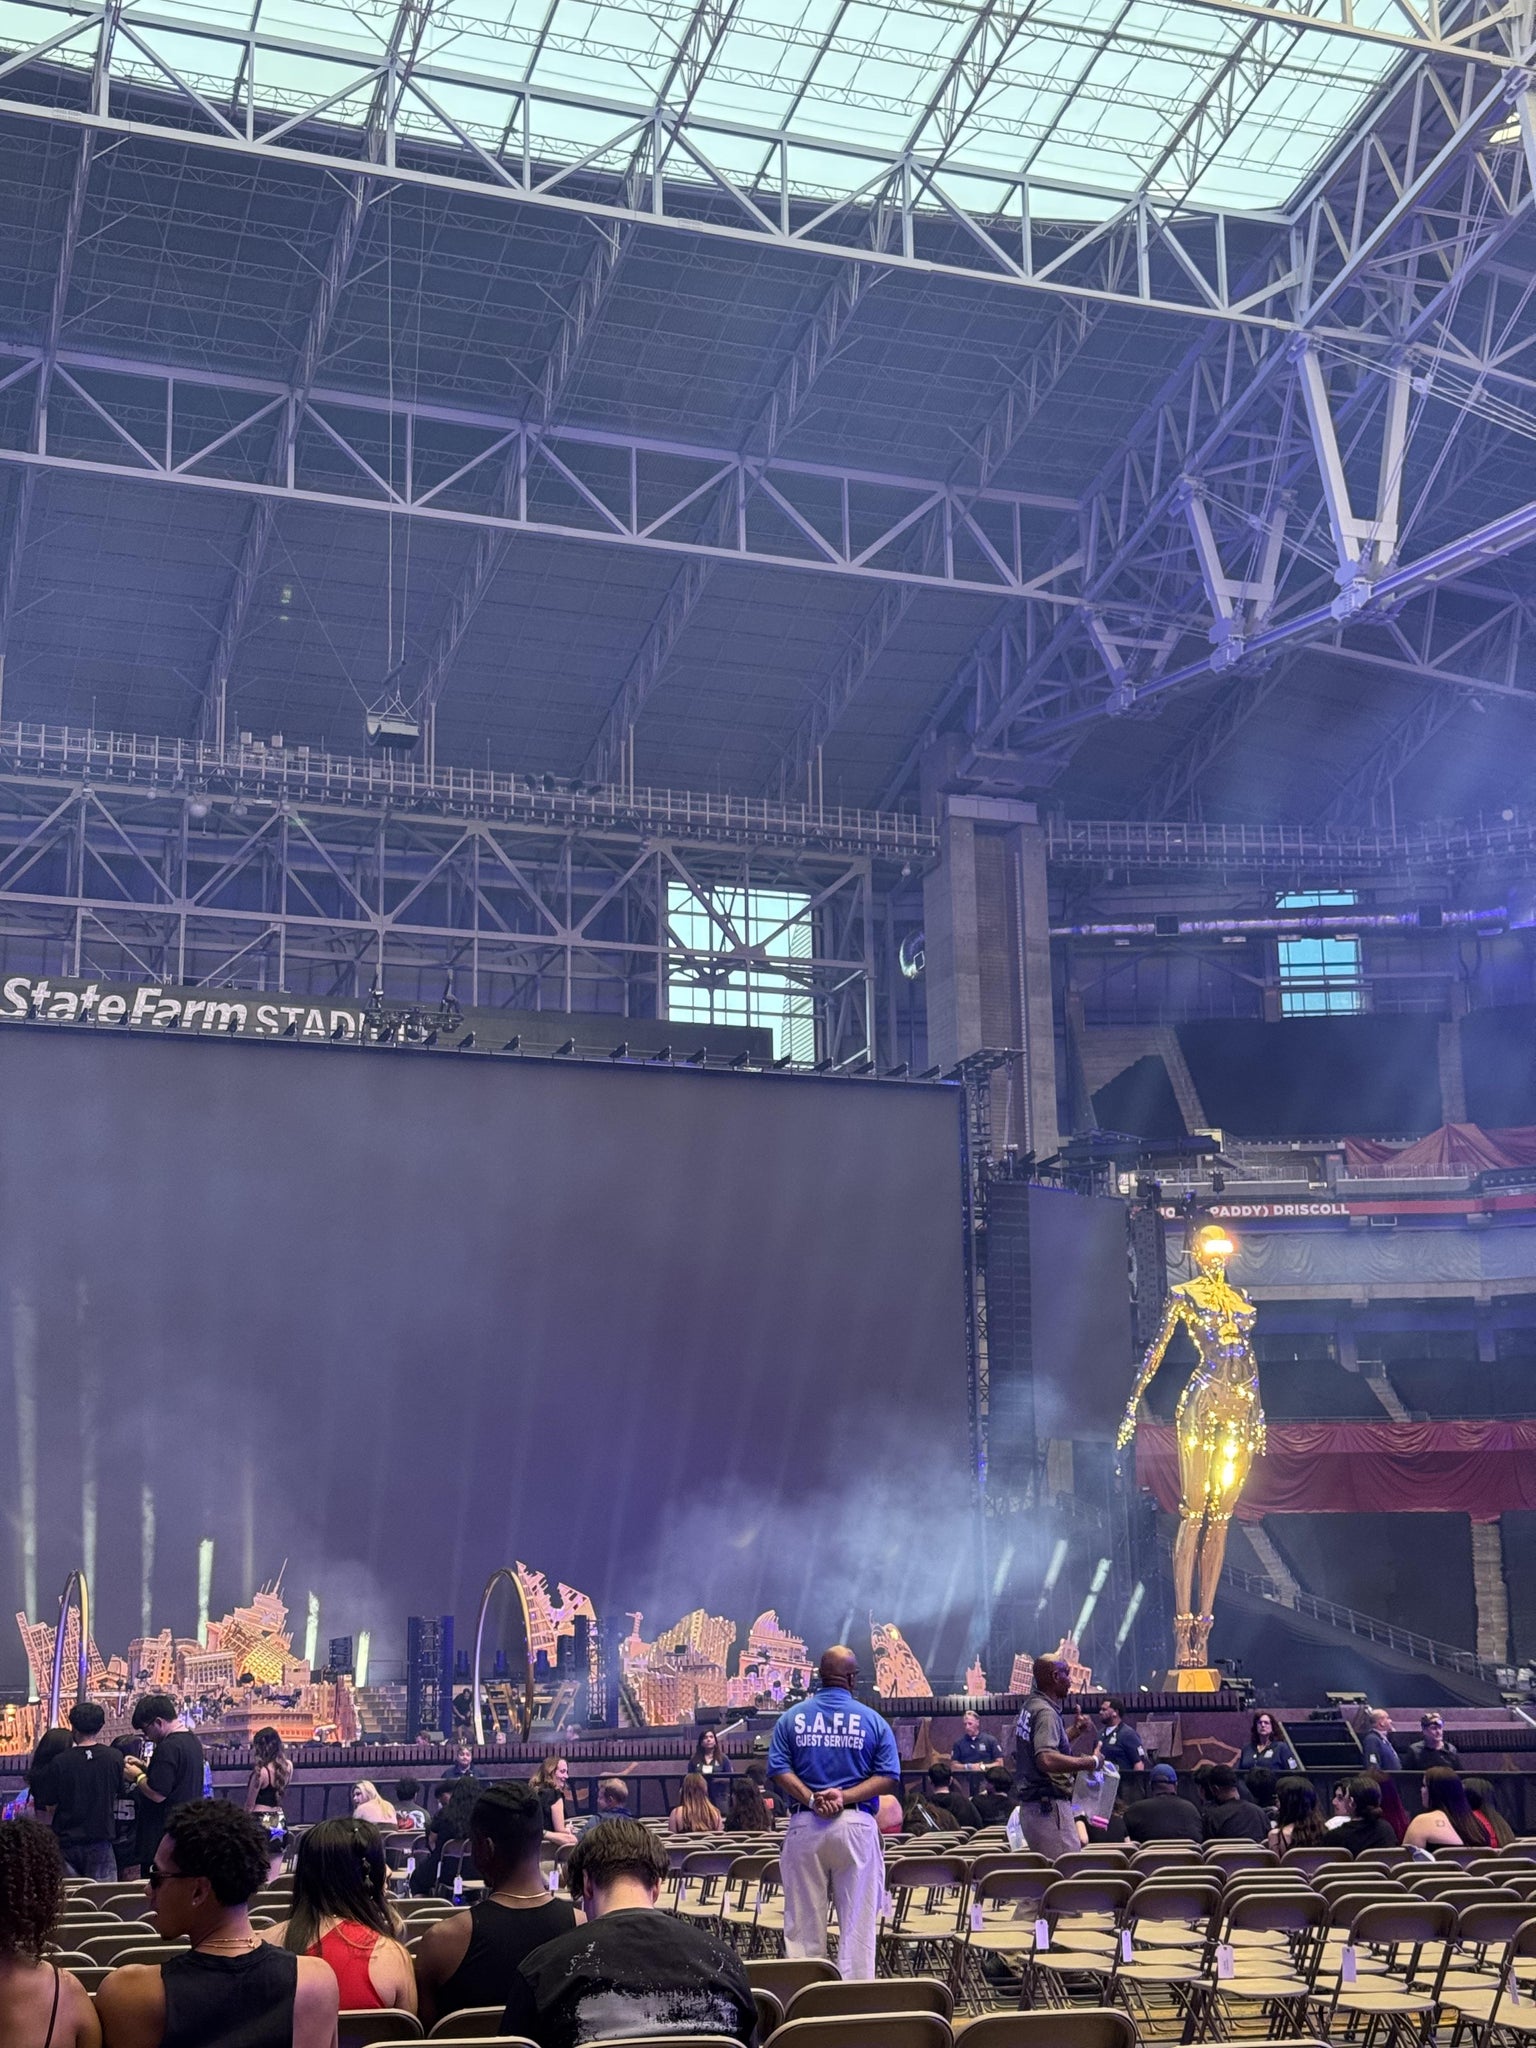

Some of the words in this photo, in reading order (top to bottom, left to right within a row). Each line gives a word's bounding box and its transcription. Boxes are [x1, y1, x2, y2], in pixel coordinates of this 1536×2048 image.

[1273, 1203, 1350, 1216] DRISCOLL
[794, 1712, 866, 1737] S.A.F.E.
[796, 1734, 822, 1747] GUEST
[824, 1734, 864, 1750] SERVICES
